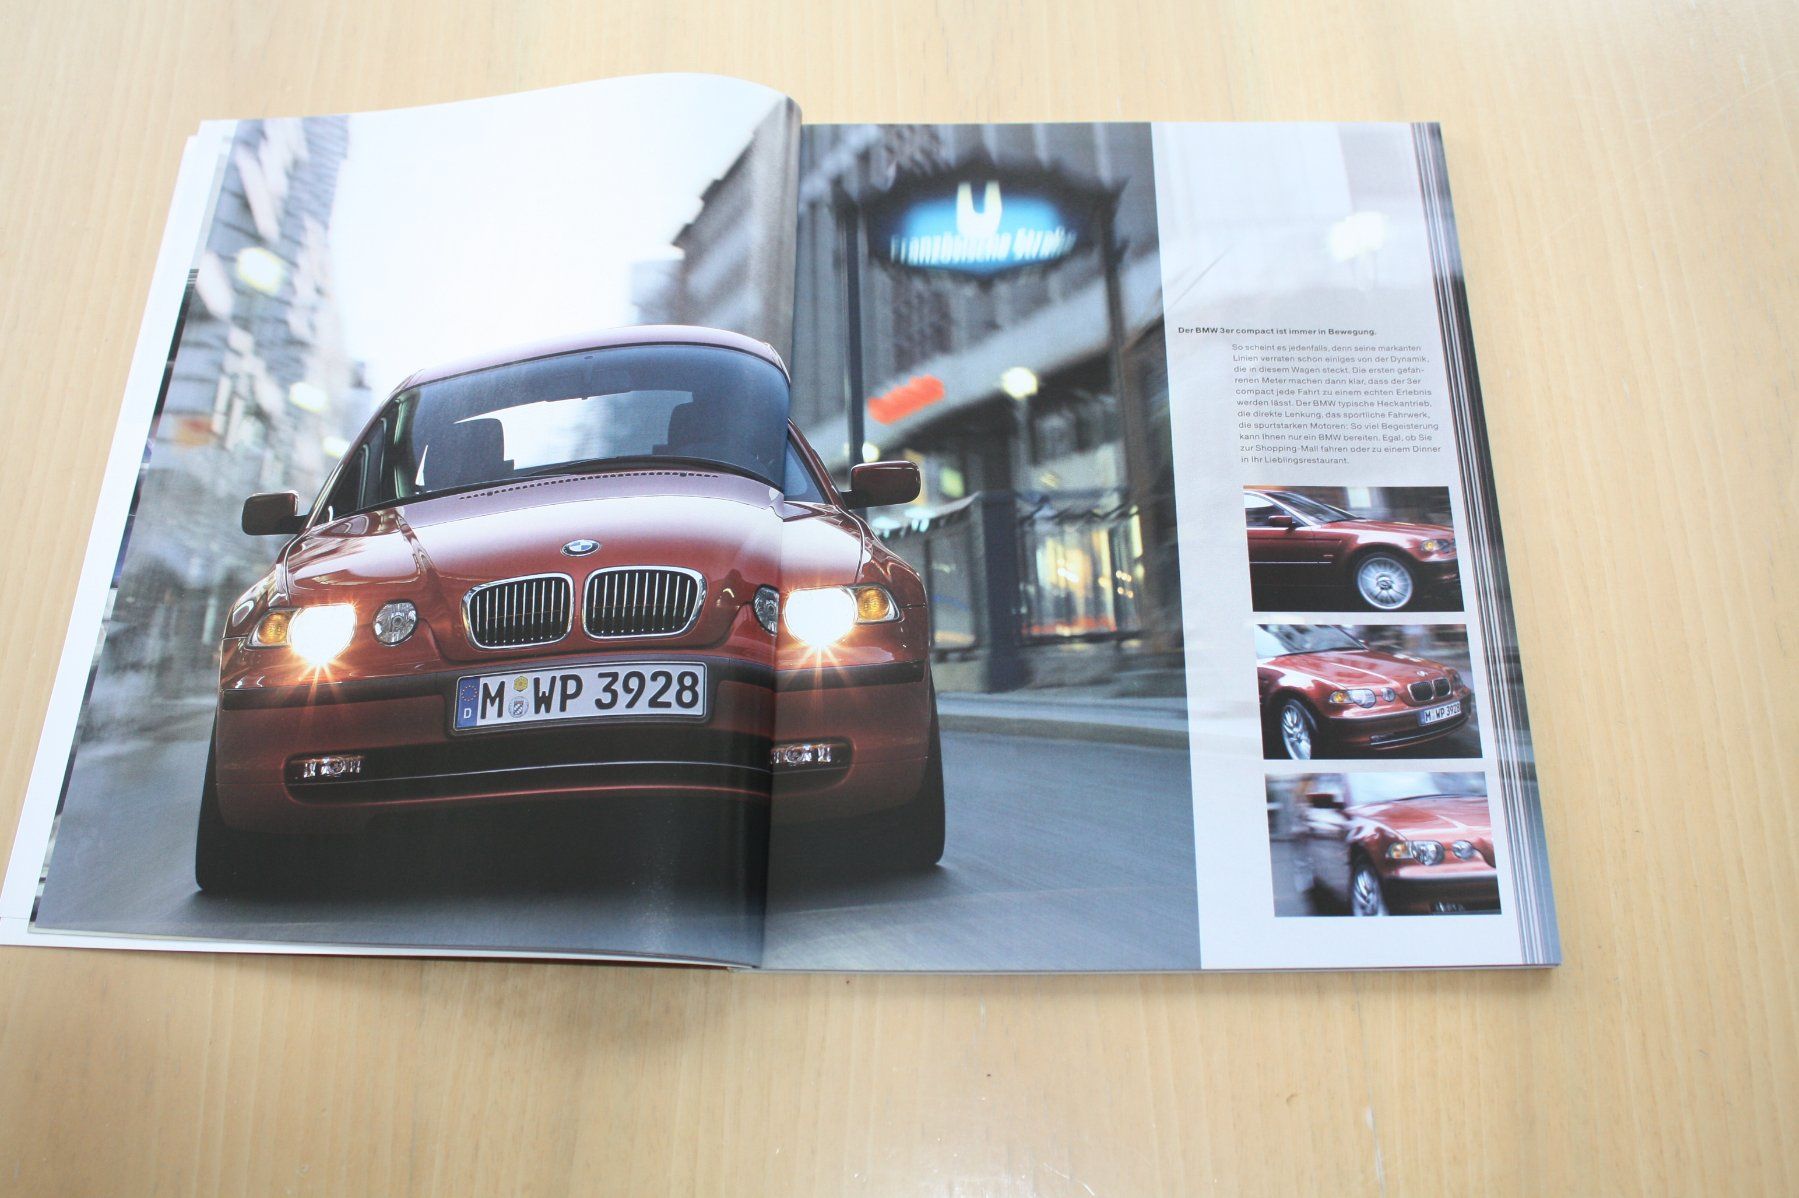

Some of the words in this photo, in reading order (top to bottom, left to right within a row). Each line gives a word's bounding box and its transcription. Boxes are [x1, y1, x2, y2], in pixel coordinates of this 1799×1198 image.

[956, 181, 1003, 237] U
[1236, 328, 1274, 336] compact
[1232, 343, 1243, 351] So
[1288, 344, 1330, 353] jedenfalls,
[1325, 355, 1356, 364] einiges
[1291, 366, 1320, 375] Wagen
[1397, 367, 1424, 375] gefah-
[1348, 377, 1366, 385] klar,
[1235, 388, 1274, 397] compact
[1276, 388, 1295, 397] jede
[1335, 388, 1361, 396] einem
[1364, 388, 1394, 396] echten
[1396, 388, 1432, 396] Erlebnis
[1338, 400, 1375, 408] typische
[1343, 411, 1385, 420] sportliche
[1254, 422, 1308, 431] spurtstarken
[1350, 422, 1363, 430] So
[1381, 423, 1439, 431] Begeisterung
[1262, 433, 1286, 441] Ihnen
[1384, 445, 1410, 453] einem
[1412, 445, 1441, 453] Dinner
[1264, 457, 1350, 465] Lieblingsrestaurant.
[480, 681, 505, 719] M
[533, 674, 584, 714] WP
[594, 670, 699, 710] 3928
[464, 707, 471, 719] D
[1425, 711, 1431, 721] M
[1436, 708, 1444, 718] WP
